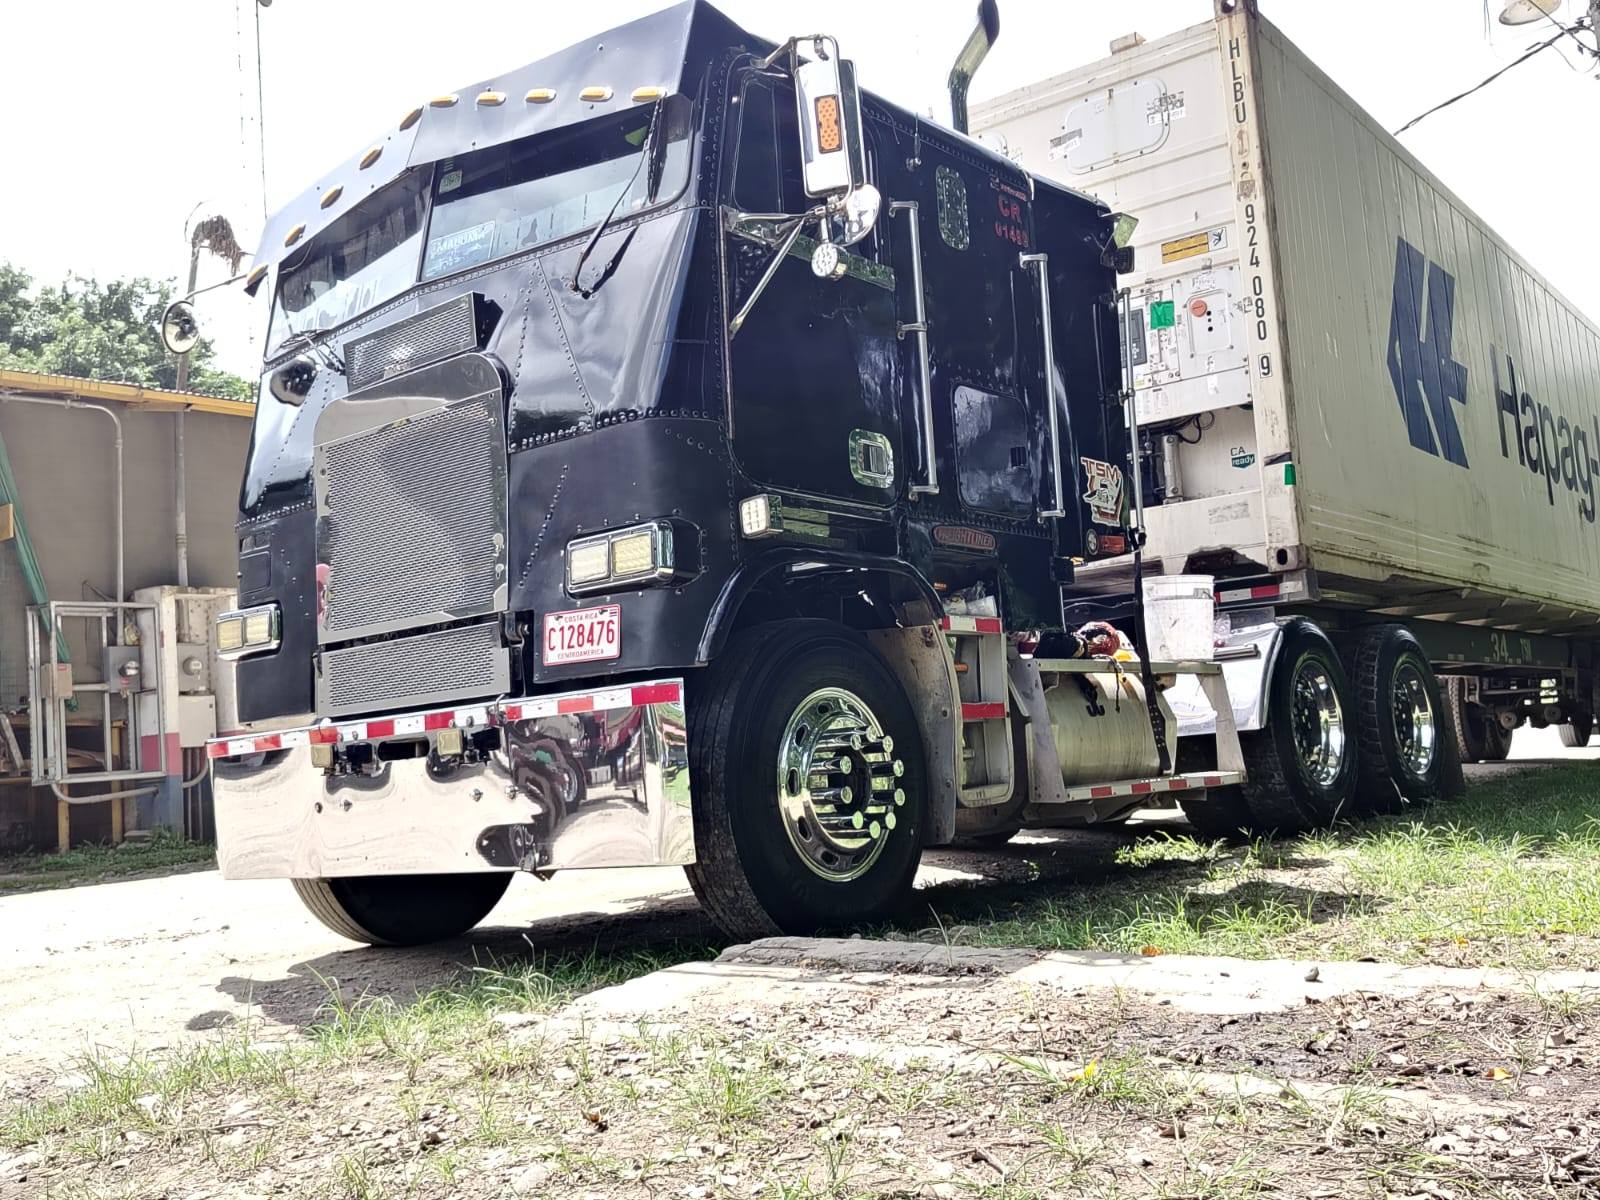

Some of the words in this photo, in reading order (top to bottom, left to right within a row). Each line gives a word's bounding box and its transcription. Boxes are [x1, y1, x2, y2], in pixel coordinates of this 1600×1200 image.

[997, 193, 1022, 224] CR
[1228, 37, 1247, 124] HLBU
[1260, 354, 1271, 377] 9
[1231, 446, 1246, 456] CA
[1233, 455, 1255, 466] ready
[1082, 459, 1119, 482] TSM
[564, 615, 583, 623] COSTA
[584, 612, 598, 620] RICA
[548, 620, 615, 650] C128476
[557, 648, 604, 660] CENTROAMERICA
[1490, 632, 1509, 662] 34
